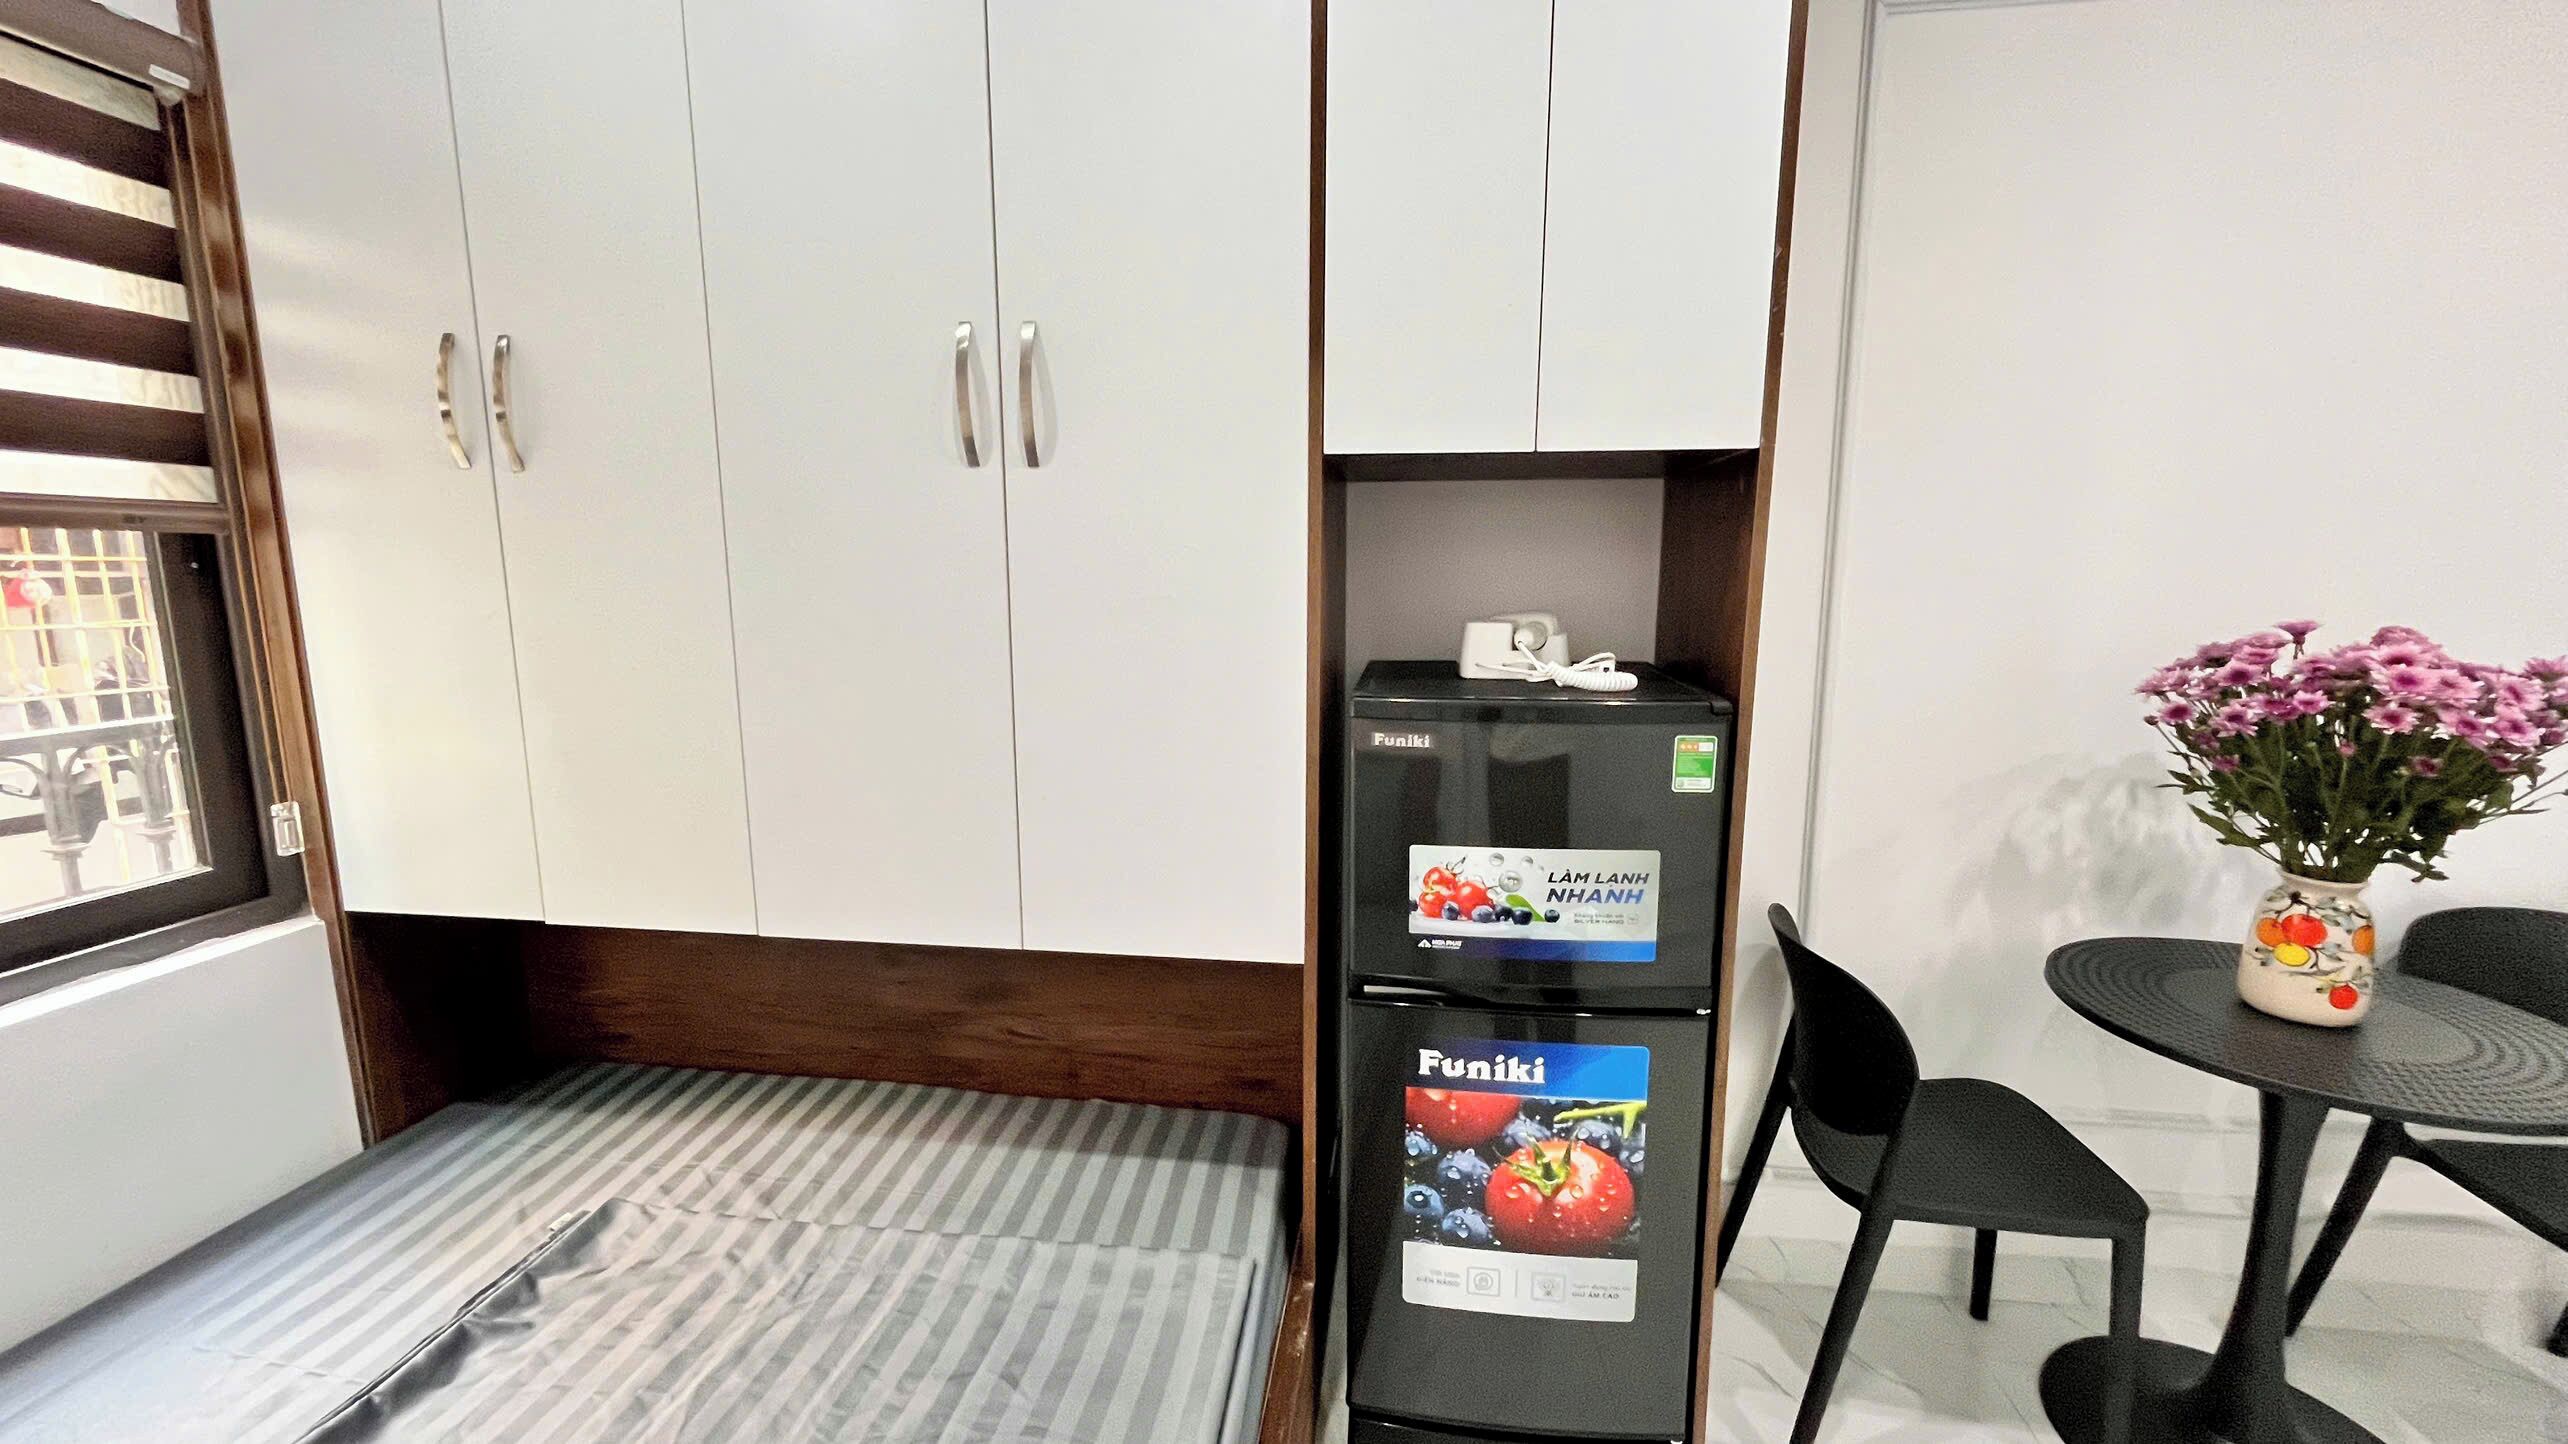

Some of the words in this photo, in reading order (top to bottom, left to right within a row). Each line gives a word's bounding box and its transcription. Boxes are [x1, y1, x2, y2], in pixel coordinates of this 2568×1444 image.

[1374, 732, 1430, 748] Funiki
[1547, 868, 1591, 884] LÀM
[1594, 872, 1650, 887] LẠNH
[1546, 888, 1644, 904] NHANH
[1418, 1048, 1545, 1084] Funiki
